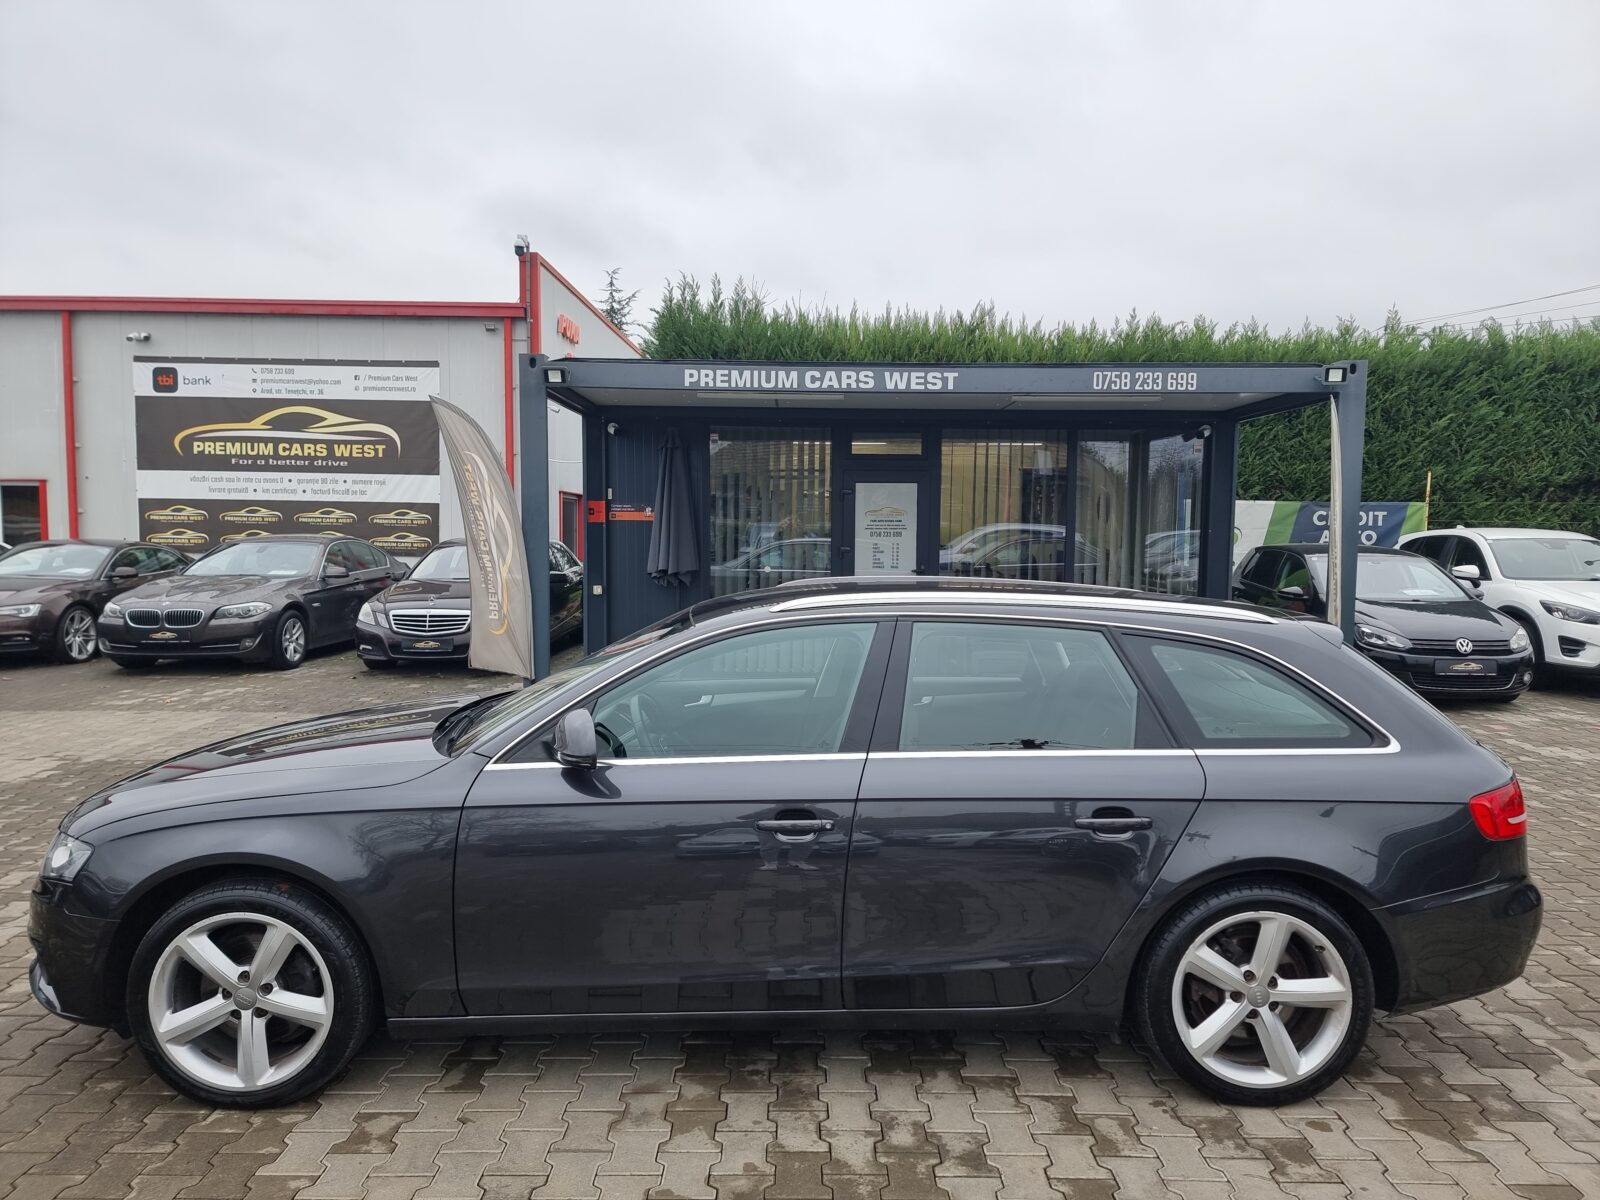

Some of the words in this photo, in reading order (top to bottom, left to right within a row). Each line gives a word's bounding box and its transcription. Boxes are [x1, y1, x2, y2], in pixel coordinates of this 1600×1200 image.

[157, 374, 174, 386] tbi
[183, 376, 212, 386] bank
[260, 378, 342, 386] premiumcarswest@yahoo.com
[684, 369, 798, 388] PREMIUM
[804, 370, 875, 389] CARS
[884, 372, 959, 390] WEST
[1093, 371, 1131, 390] 0758
[1134, 372, 1162, 390] 233
[1167, 372, 1197, 391] 699
[193, 441, 274, 456] PREMIUM
[278, 443, 328, 457] CARS
[334, 444, 387, 458] WEST
[269, 458, 309, 466] better
[314, 459, 348, 467] drive
[1312, 510, 1387, 526] CDIT
